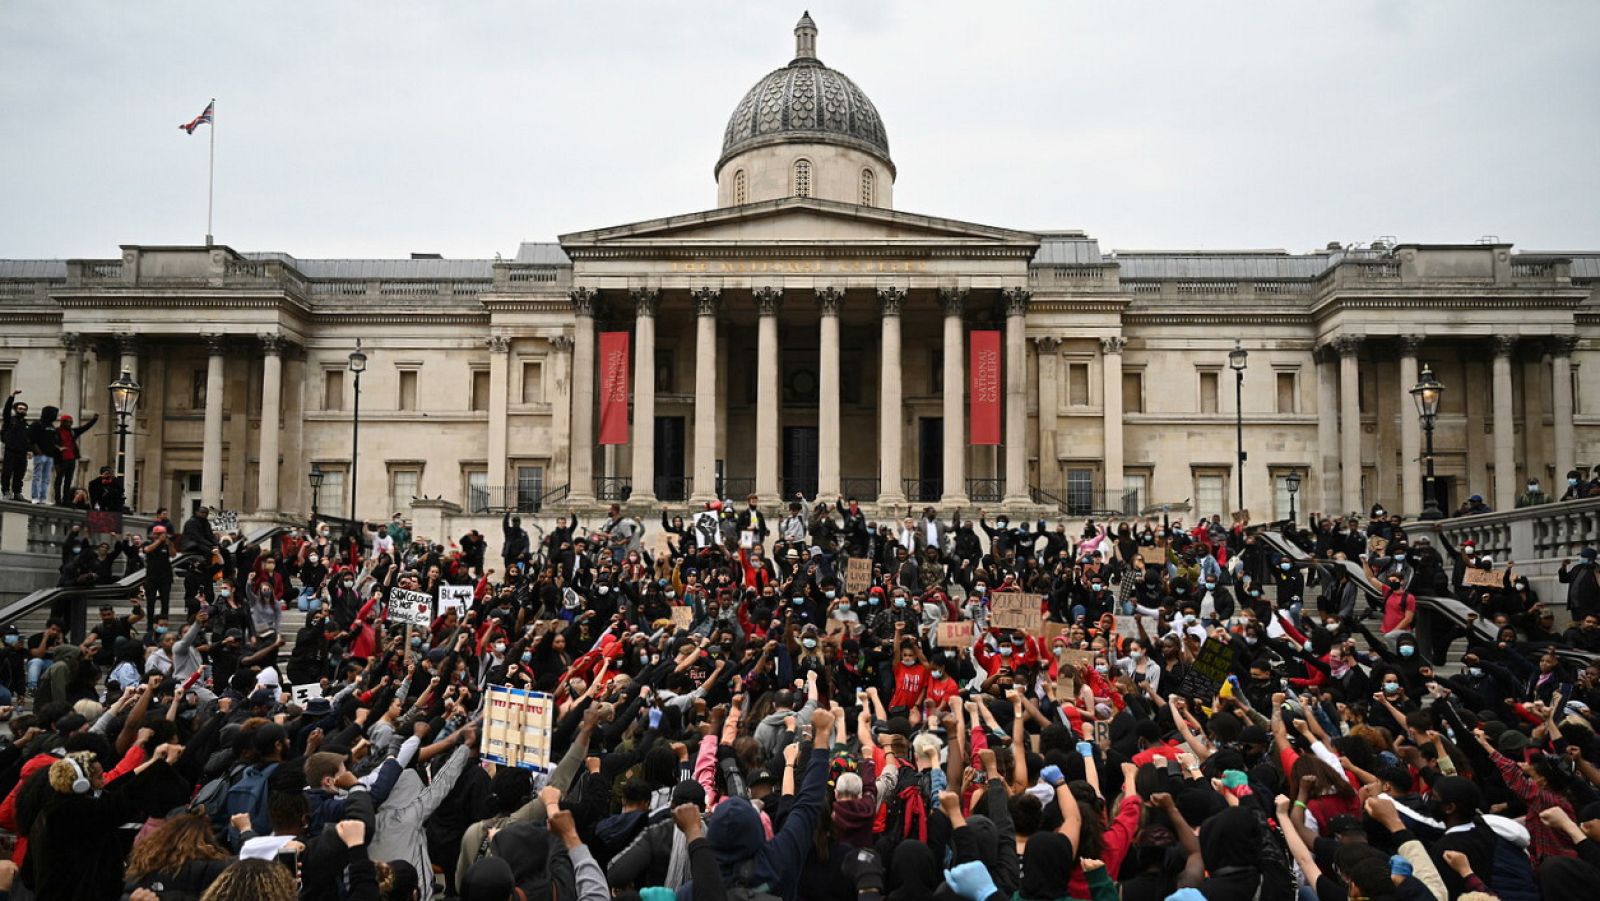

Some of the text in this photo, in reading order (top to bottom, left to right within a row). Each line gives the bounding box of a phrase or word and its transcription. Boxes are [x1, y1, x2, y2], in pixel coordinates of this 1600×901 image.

[720, 262, 821, 272] NATIONAL
[839, 262, 927, 272] GALLERY
[979, 351, 988, 401] NATIONAL
[987, 351, 997, 402] GALLERY
[946, 624, 970, 639] BLM
